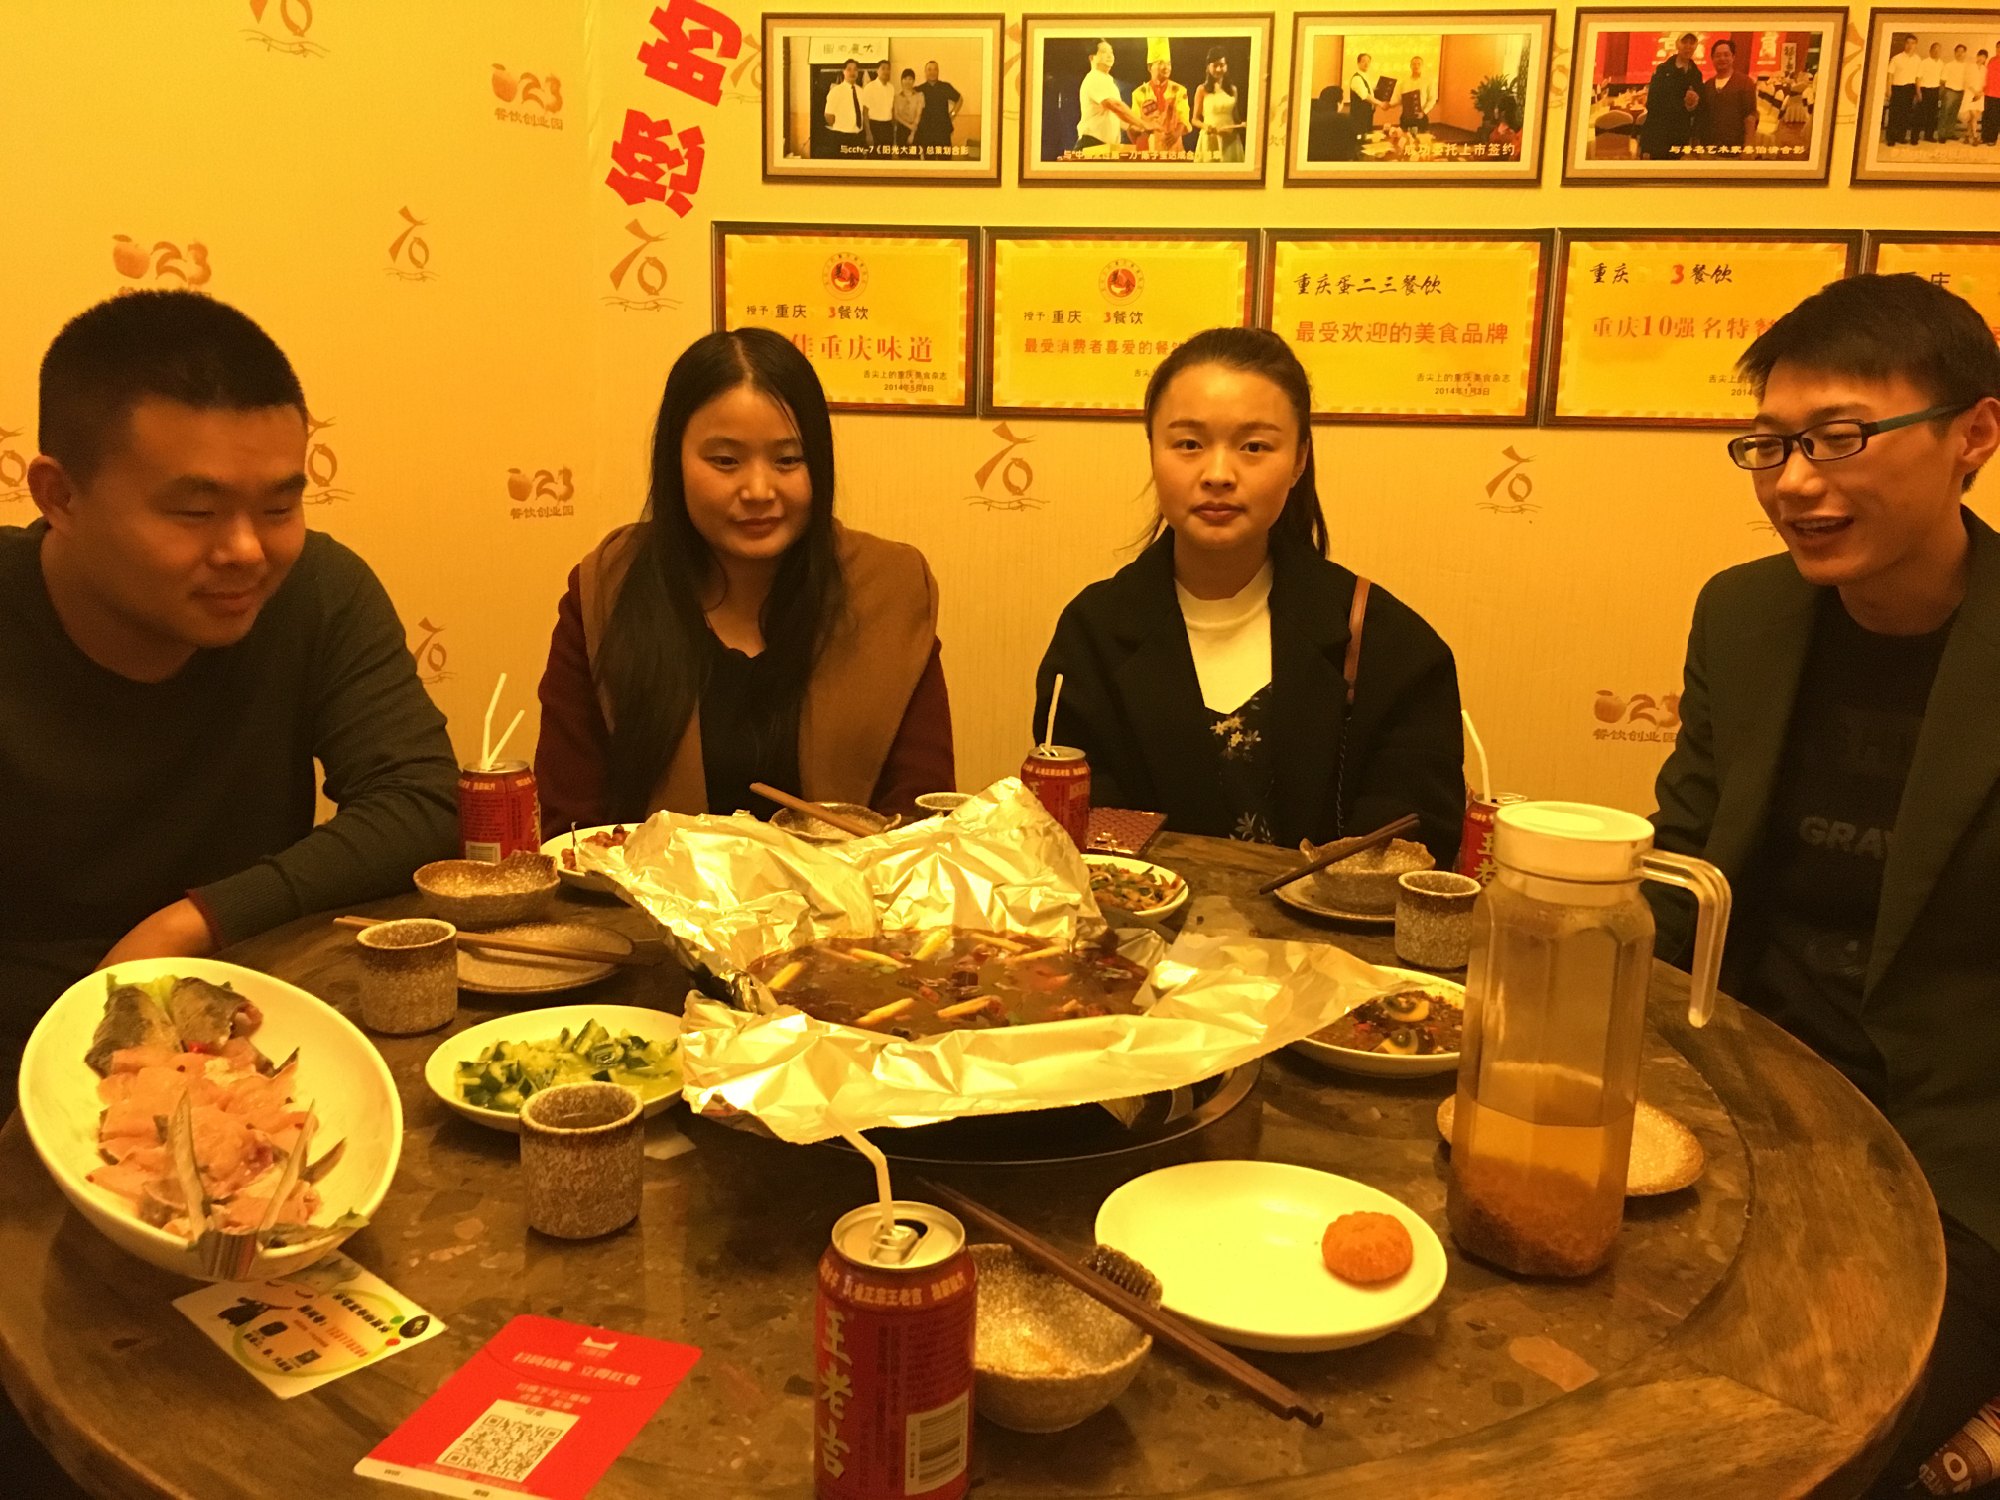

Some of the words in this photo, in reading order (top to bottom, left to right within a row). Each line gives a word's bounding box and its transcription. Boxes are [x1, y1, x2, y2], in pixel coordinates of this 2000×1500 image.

[1294, 272, 1442, 296] 重庆蛋二三餐饮
[1590, 262, 1629, 284] 重庆
[776, 304, 807, 319] 重庆
[1052, 310, 1082, 324] 重庆
[1296, 321, 1509, 345] 最受欢迎的美食品牌
[1801, 816, 1894, 860] GRA
